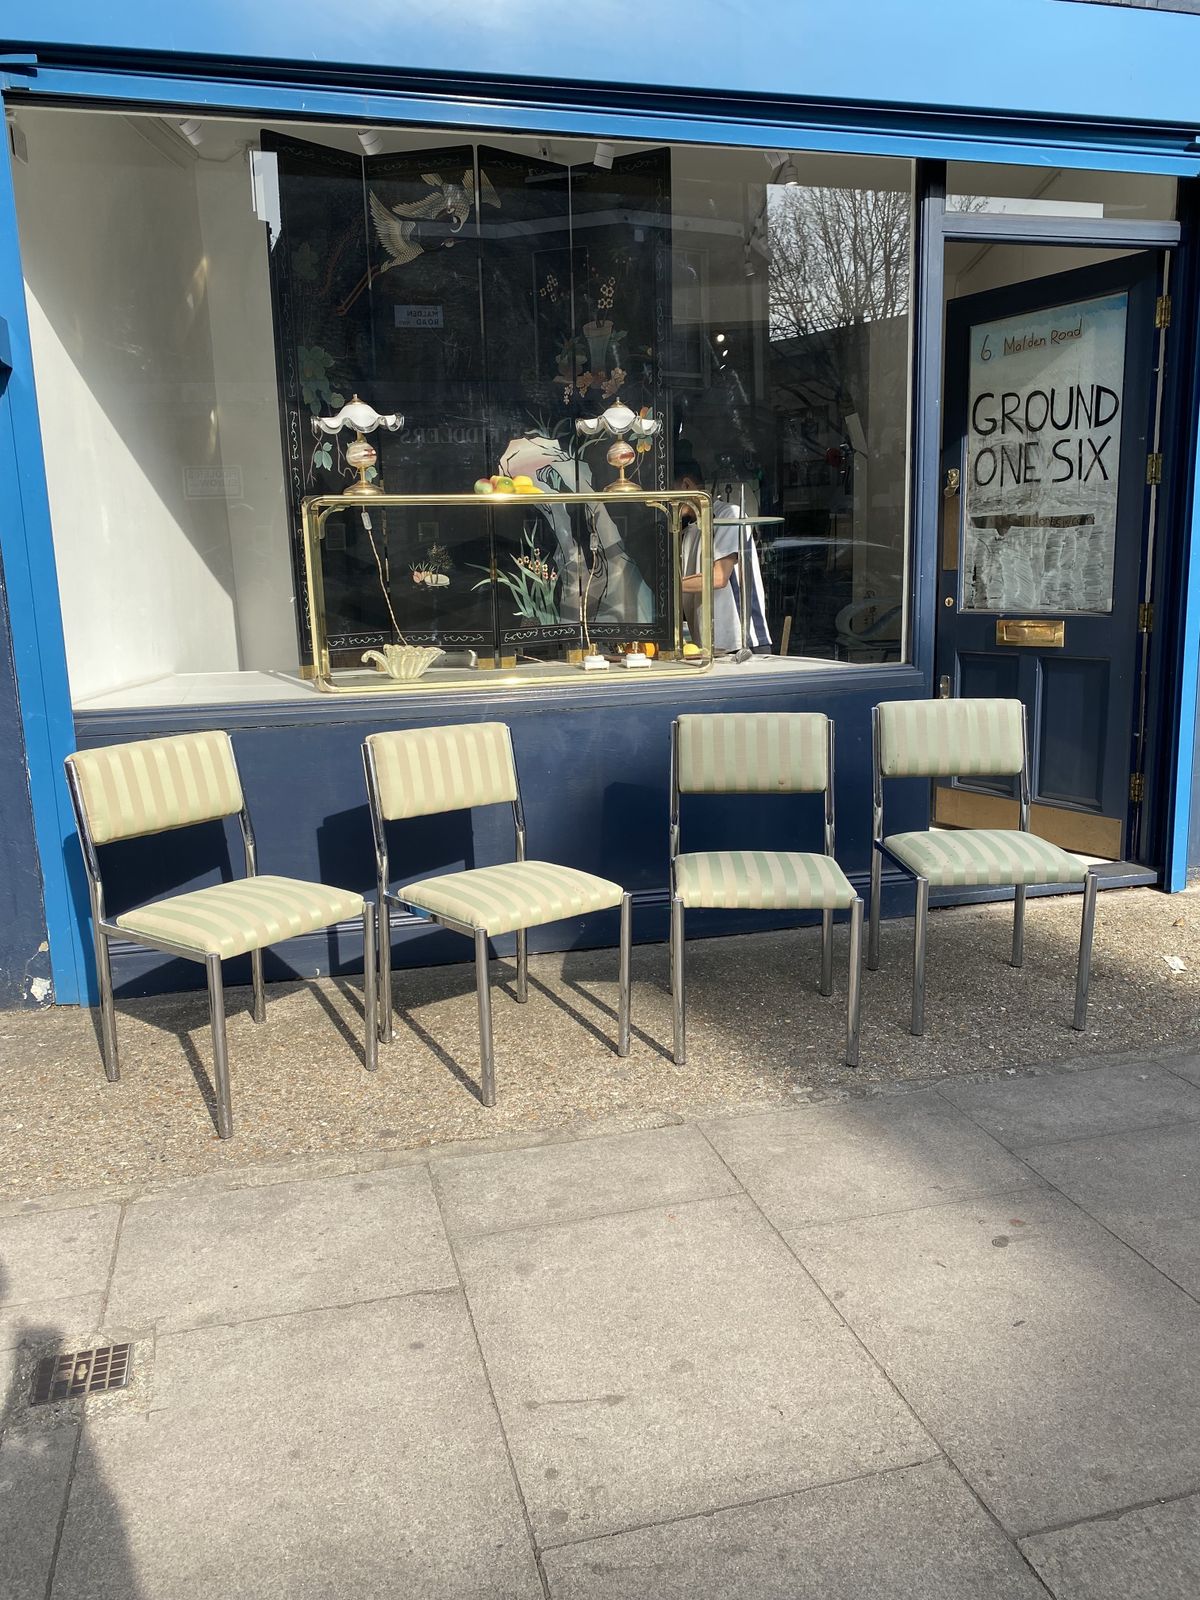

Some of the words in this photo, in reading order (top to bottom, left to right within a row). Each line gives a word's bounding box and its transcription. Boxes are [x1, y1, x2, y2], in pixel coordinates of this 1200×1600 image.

[980, 333, 993, 361] 6
[1003, 332, 1047, 356] Malden
[1050, 317, 1083, 345] Road
[972, 384, 1120, 436] GROUND
[974, 442, 1042, 487] ONE
[1052, 435, 1112, 483] SIX
